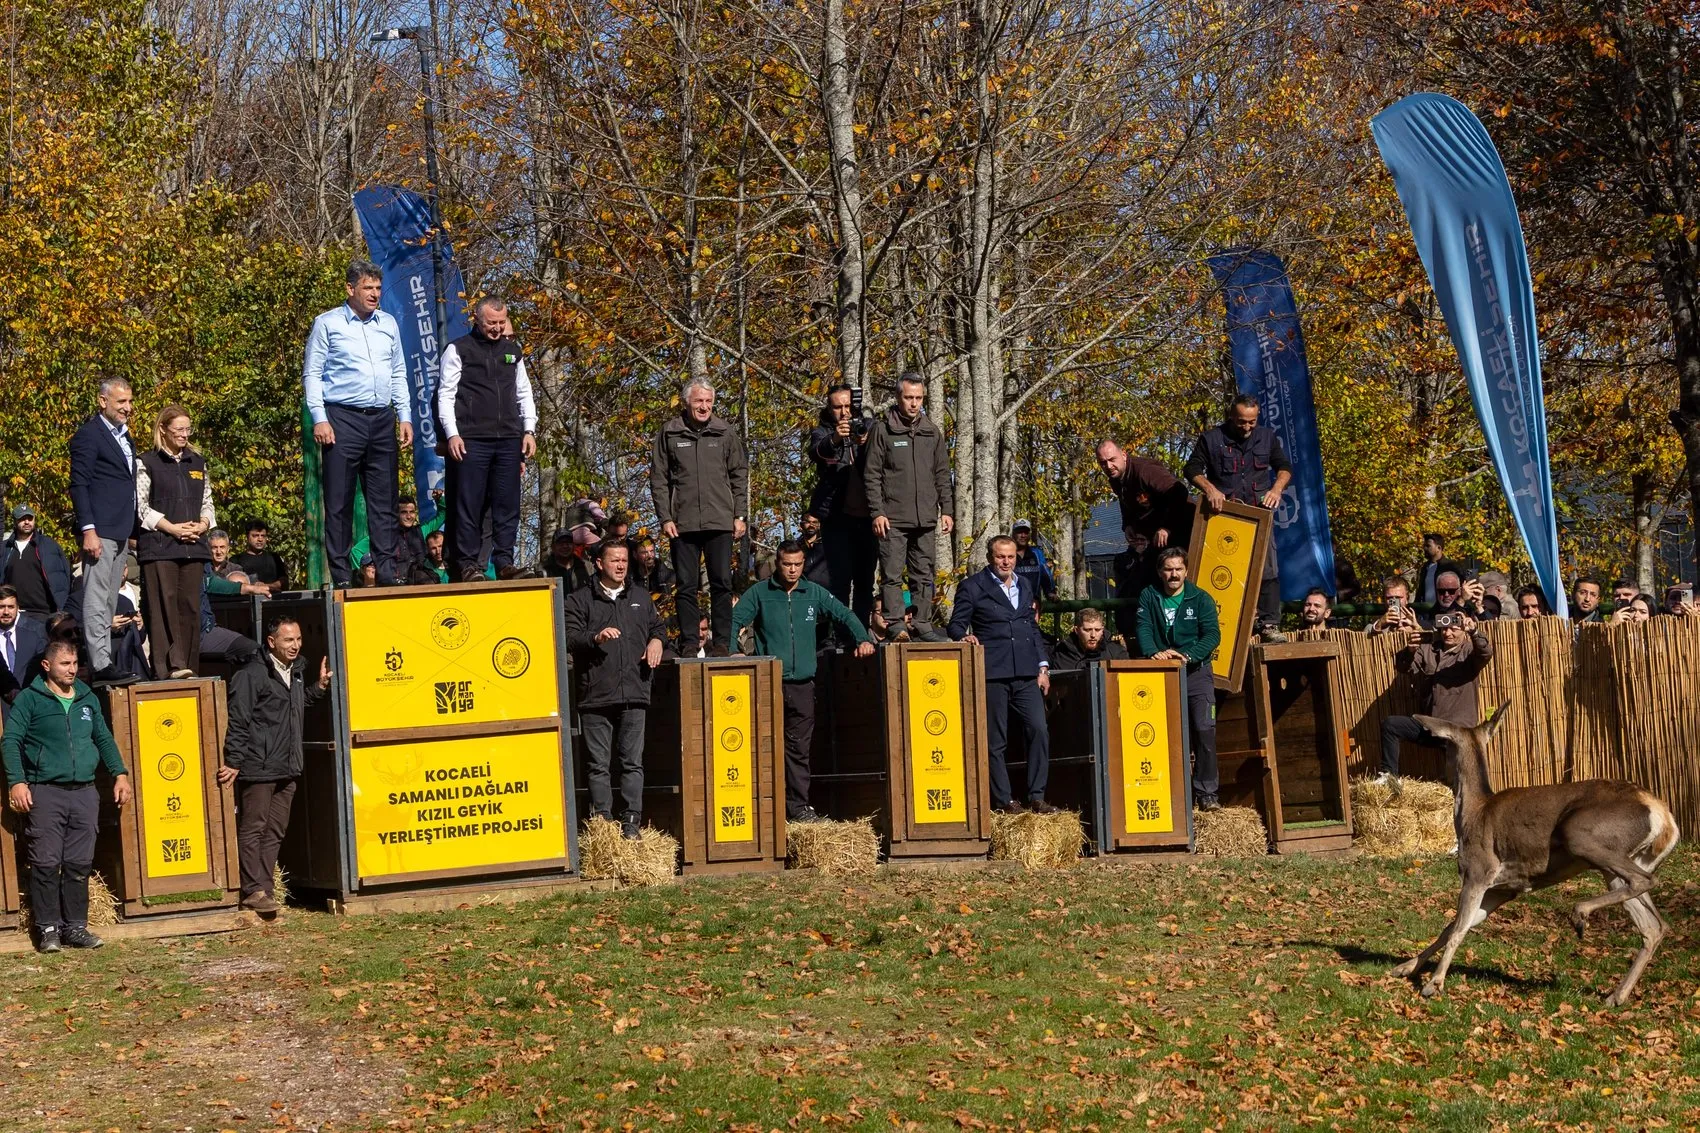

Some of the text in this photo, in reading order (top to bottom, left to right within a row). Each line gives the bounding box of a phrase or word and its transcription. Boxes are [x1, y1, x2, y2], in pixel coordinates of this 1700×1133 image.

[409, 274, 440, 396] ÜKŞEHİR
[410, 352, 437, 449] KOCAELİ
[1256, 322, 1285, 449] YÜKŞEHİR
[425, 761, 491, 782] KOCAELİ
[388, 780, 529, 805] SAMANLI DAĞLARI
[417, 800, 503, 822] KIZIL GEYİK
[378, 814, 543, 845] YERLEŞTİRME PROJESİ
